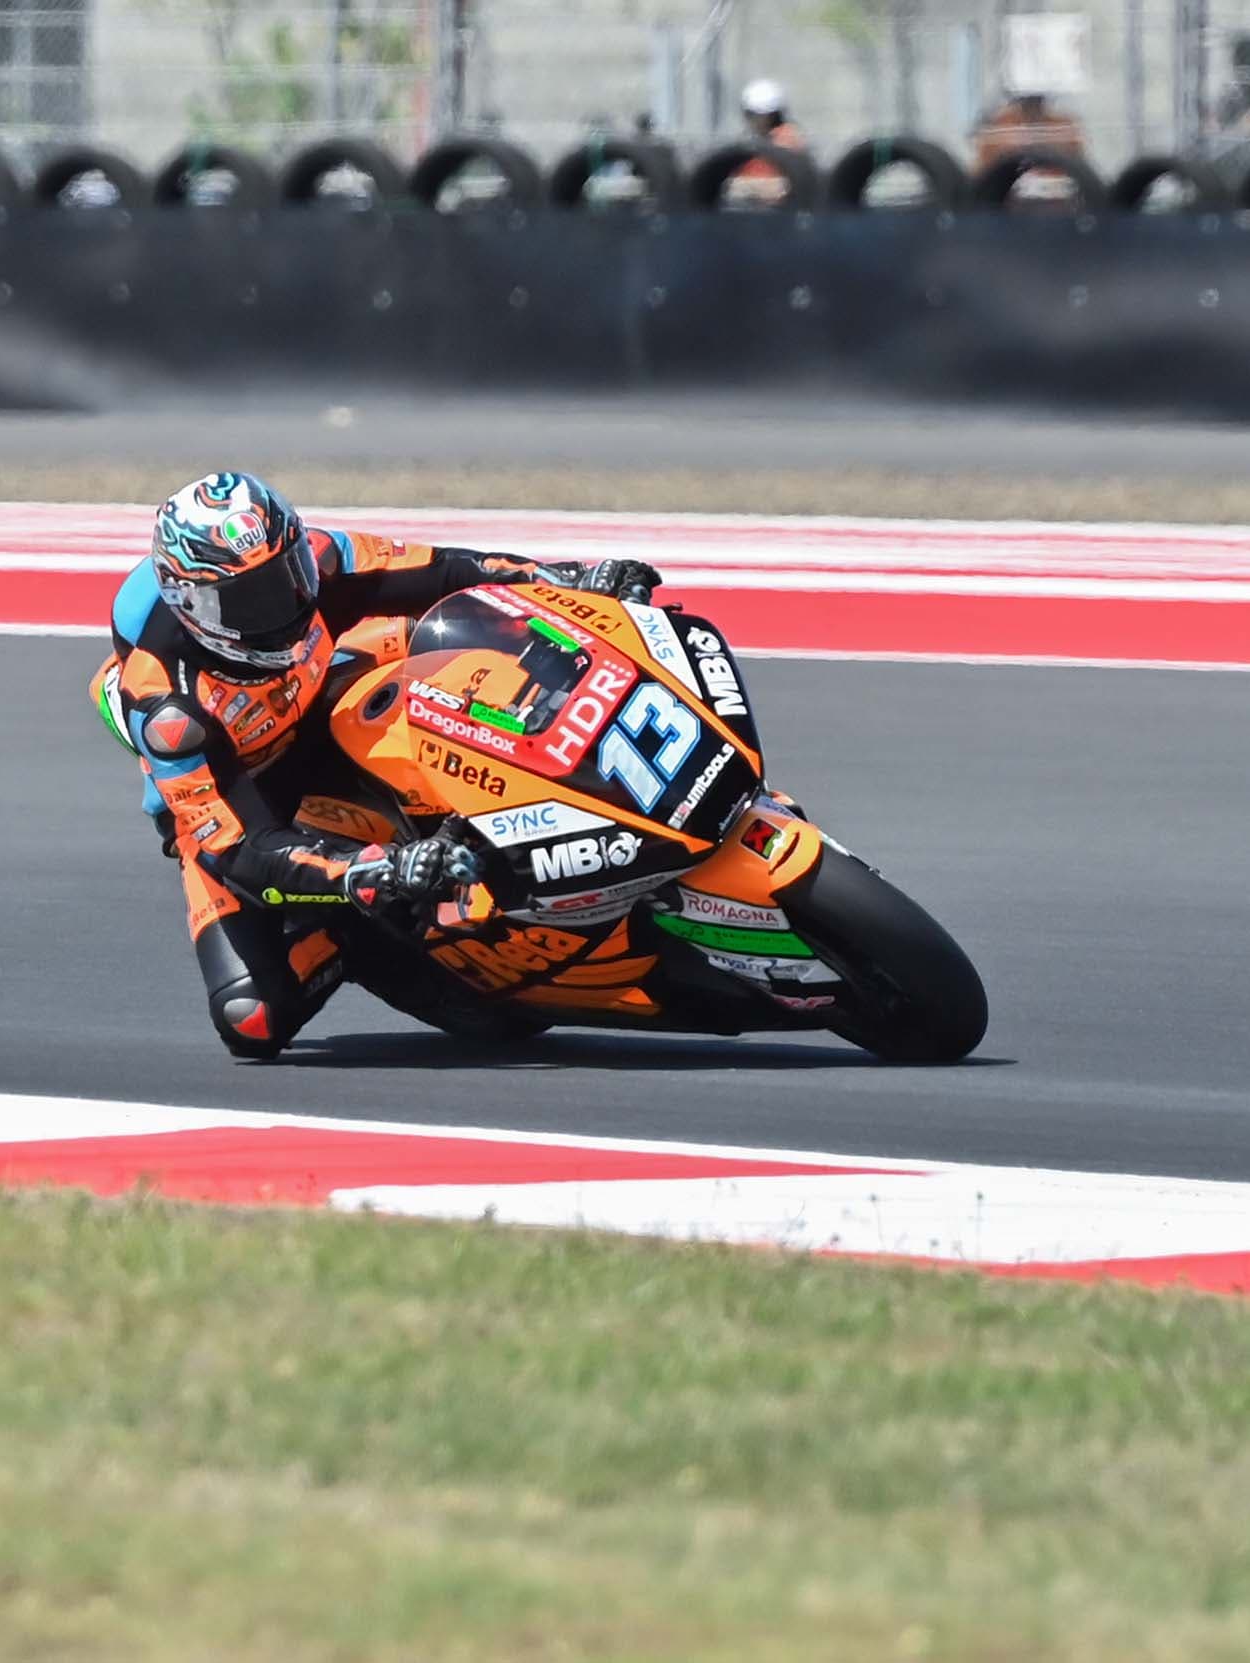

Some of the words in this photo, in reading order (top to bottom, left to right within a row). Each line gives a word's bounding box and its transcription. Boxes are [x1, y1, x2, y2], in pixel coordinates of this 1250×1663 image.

[236, 527, 261, 549] agv
[534, 586, 597, 621] Beta
[636, 613, 675, 661] SYNC
[409, 698, 518, 755] DragonBox
[545, 668, 626, 767] HDR
[597, 682, 701, 815] 13
[442, 750, 507, 798] Beta
[491, 807, 557, 836] SYNC
[681, 892, 779, 924] ROMAGNA
